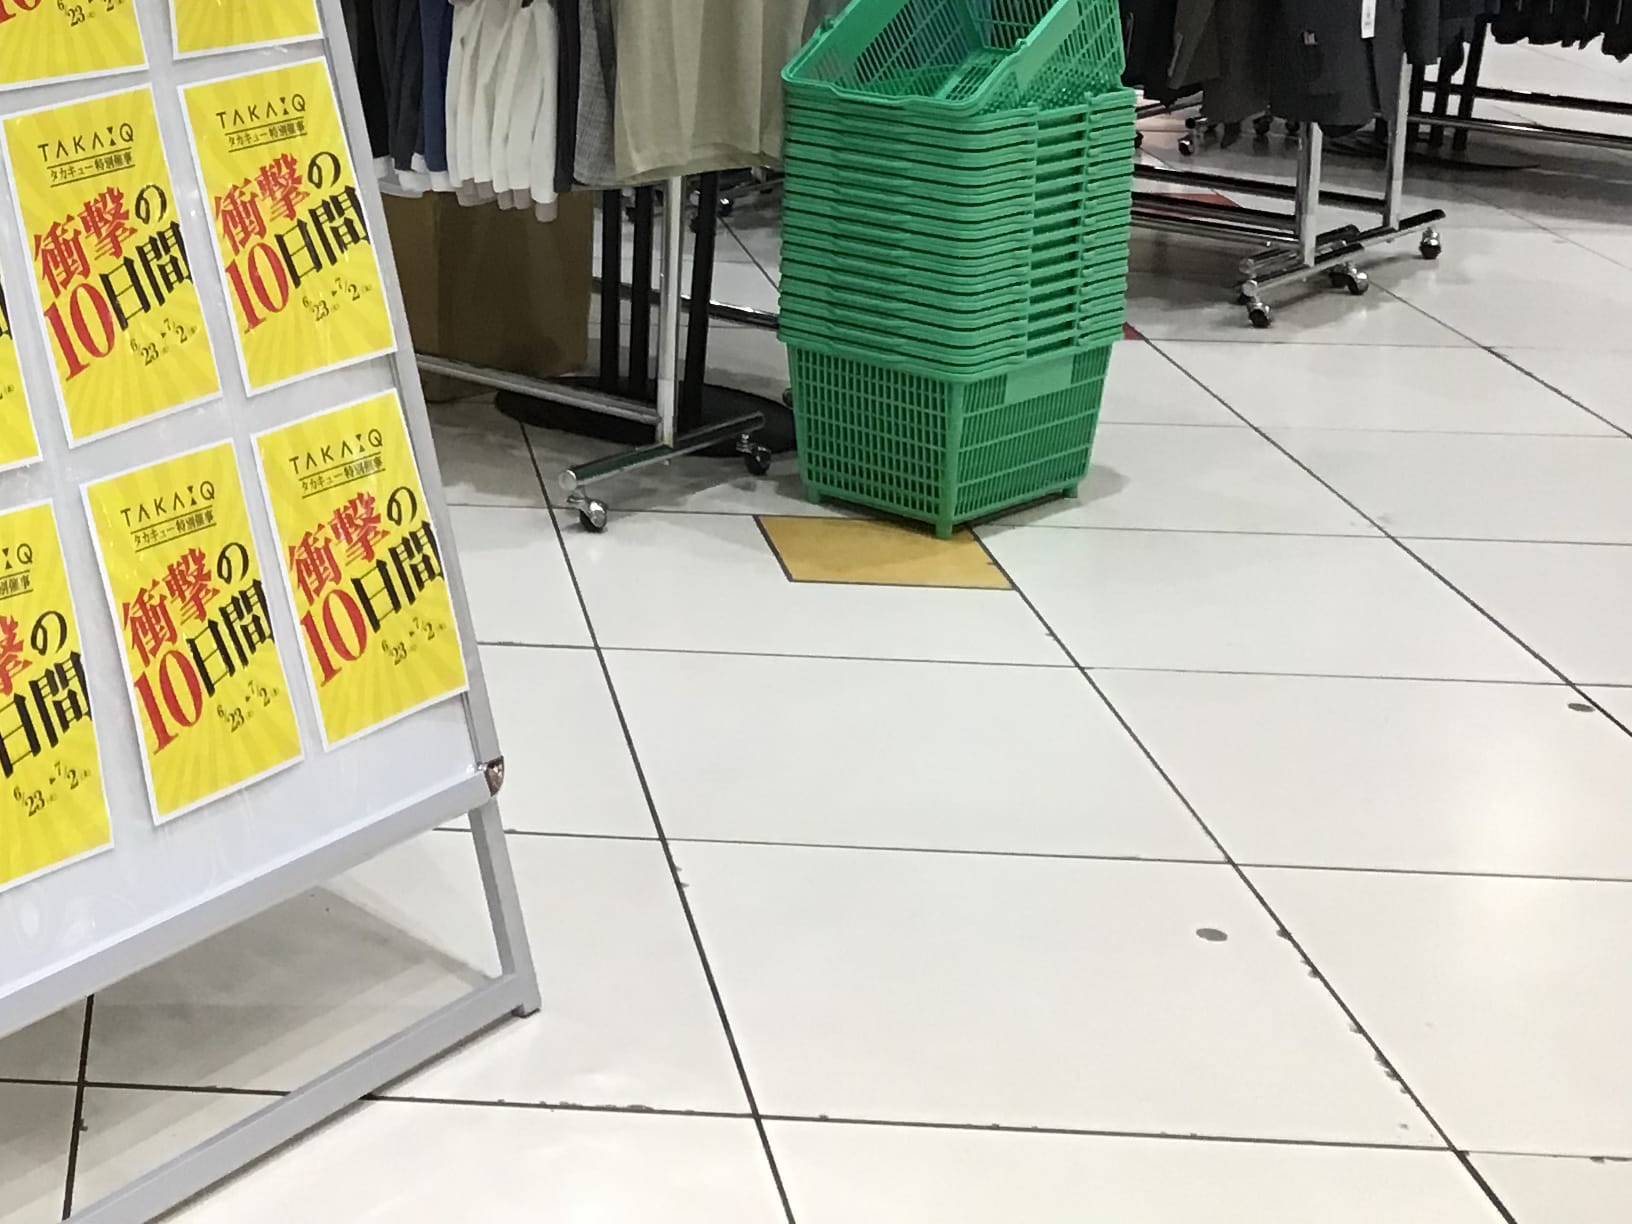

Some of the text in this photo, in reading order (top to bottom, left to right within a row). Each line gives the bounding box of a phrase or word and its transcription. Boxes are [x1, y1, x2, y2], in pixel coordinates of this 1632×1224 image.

[34, 184, 168, 295] 衝撃の
[214, 151, 341, 252] 衝撃の
[224, 185, 371, 335] 10日間
[44, 220, 192, 382] 10日間
[123, 541, 249, 666] 衝撃の
[288, 485, 417, 606] 衝撃の
[299, 520, 445, 686] 10日間
[134, 578, 275, 756] 10日間
